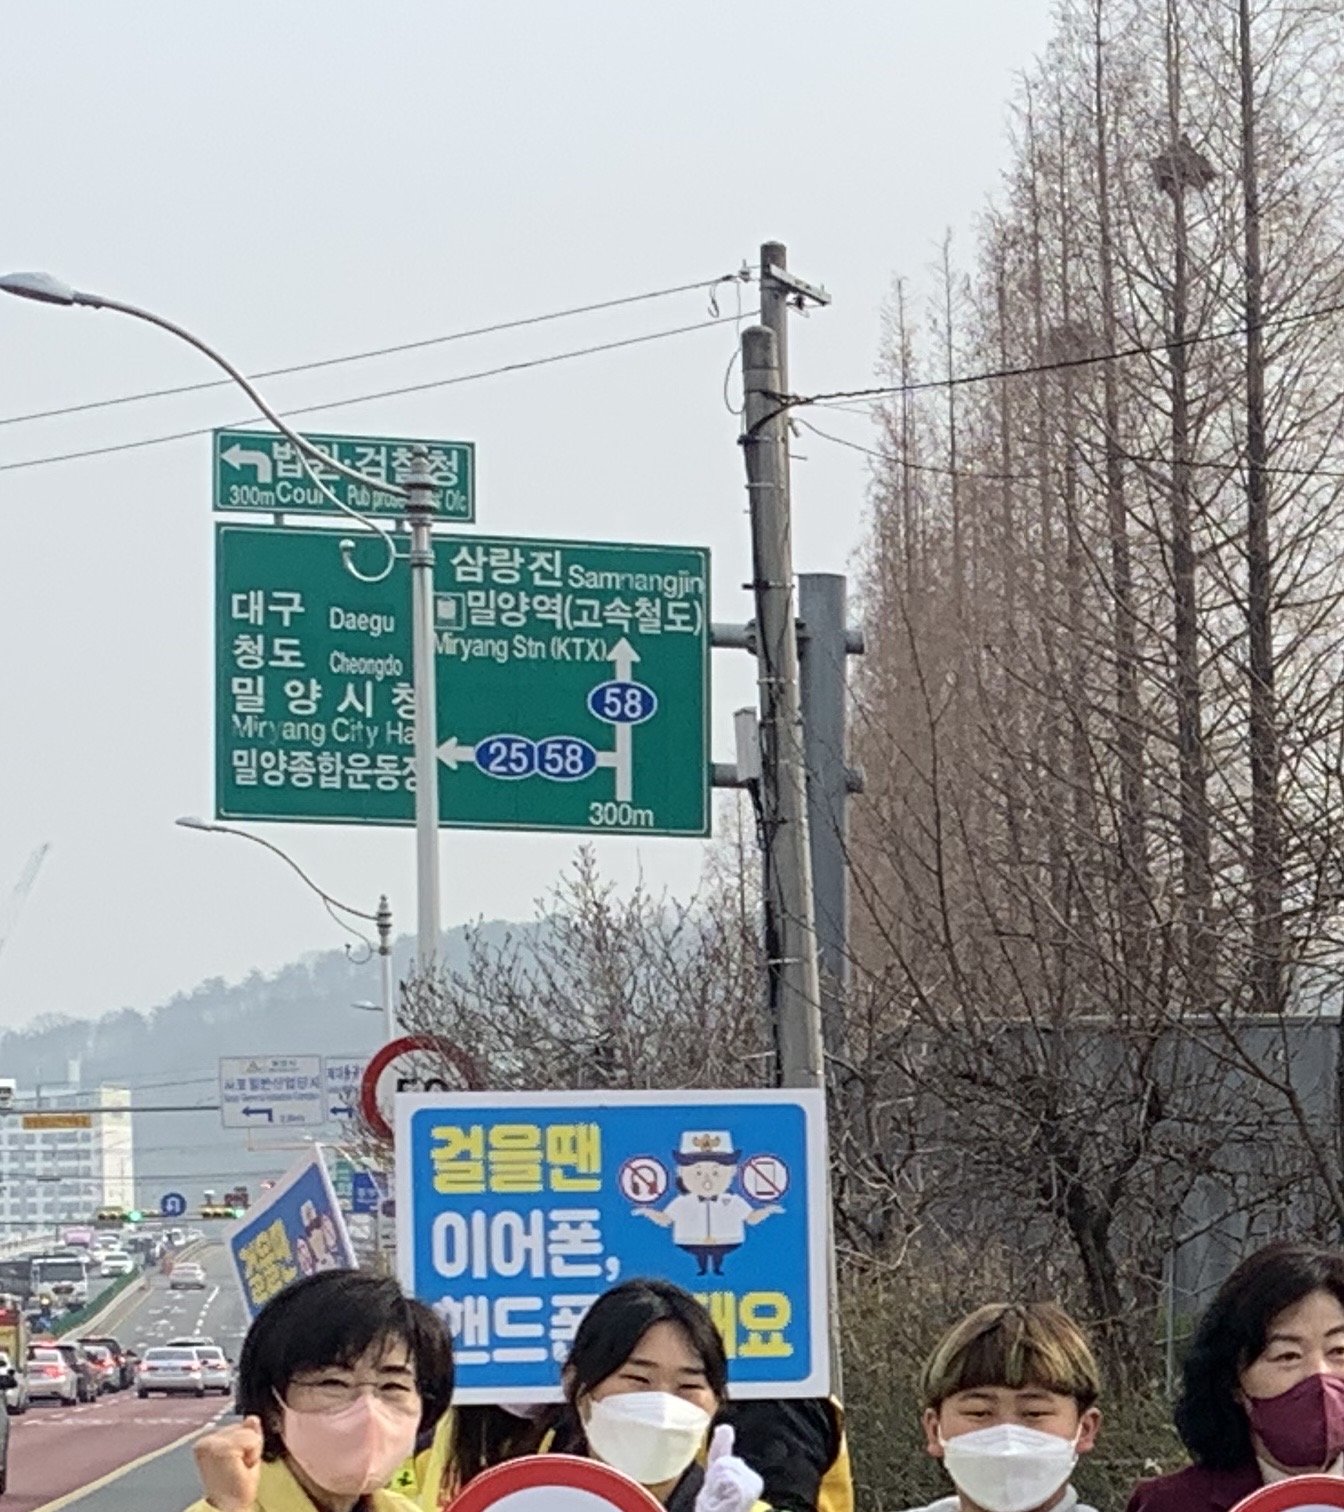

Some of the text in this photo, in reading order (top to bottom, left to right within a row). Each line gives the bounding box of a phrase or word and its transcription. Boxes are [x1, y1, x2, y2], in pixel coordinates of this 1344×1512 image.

[229, 485, 275, 506] 300m
[450, 546, 563, 587] 삼랑진
[231, 590, 395, 637] 대구 Daegu
[466, 588, 702, 636] 밀양역(고속철도)
[233, 634, 403, 681] 청도 Cheongdo
[434, 632, 608, 663] Miryang Stn (KTX)
[603, 688, 643, 719] 58
[231, 714, 416, 749] Miryang City Ha
[488, 742, 584, 774] 25 58
[588, 801, 655, 828] 300m
[430, 1122, 601, 1194] 걸을땐
[432, 1208, 621, 1281] 이어폰,
